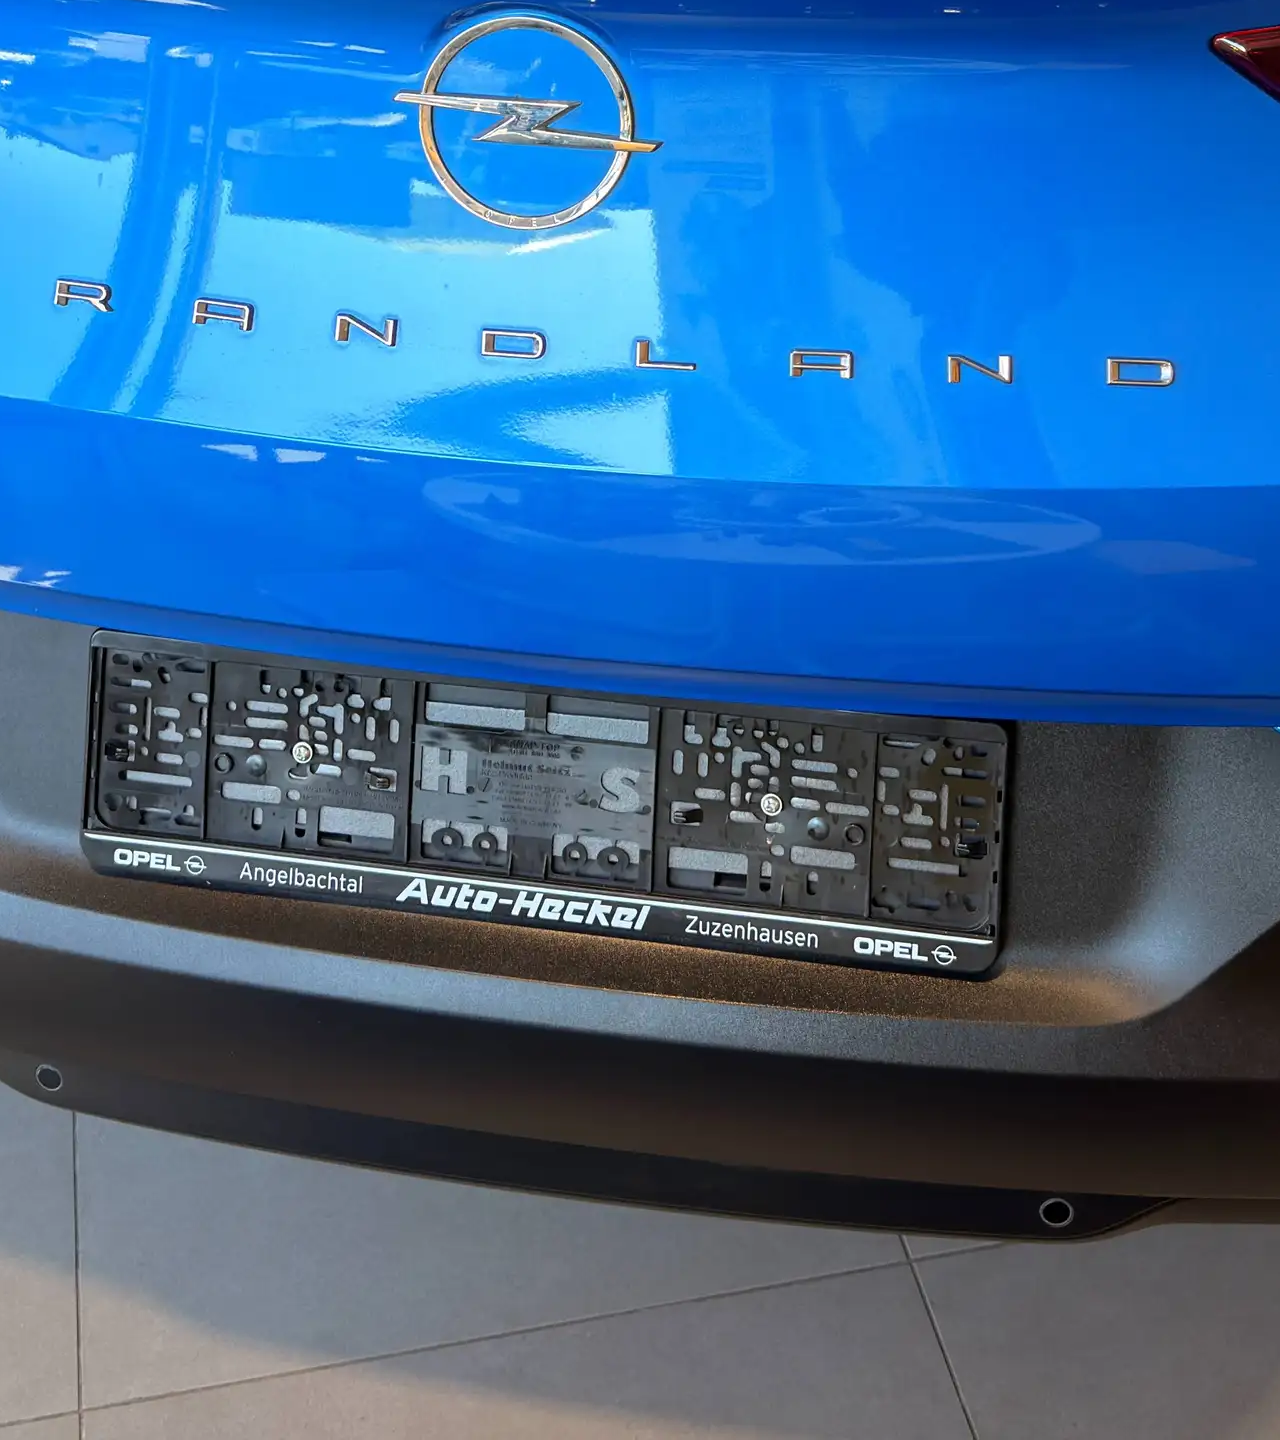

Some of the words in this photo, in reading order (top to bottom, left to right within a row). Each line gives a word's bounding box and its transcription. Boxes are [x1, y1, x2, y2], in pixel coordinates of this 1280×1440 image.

[484, 209, 561, 228] OPEL
[598, 767, 641, 813] S
[113, 848, 181, 872] OPEL
[239, 861, 364, 894] Angelbachtal
[396, 877, 651, 931] Auto-Heckel
[684, 914, 820, 949] Zuzenhausen
[853, 936, 928, 962] OPEL
